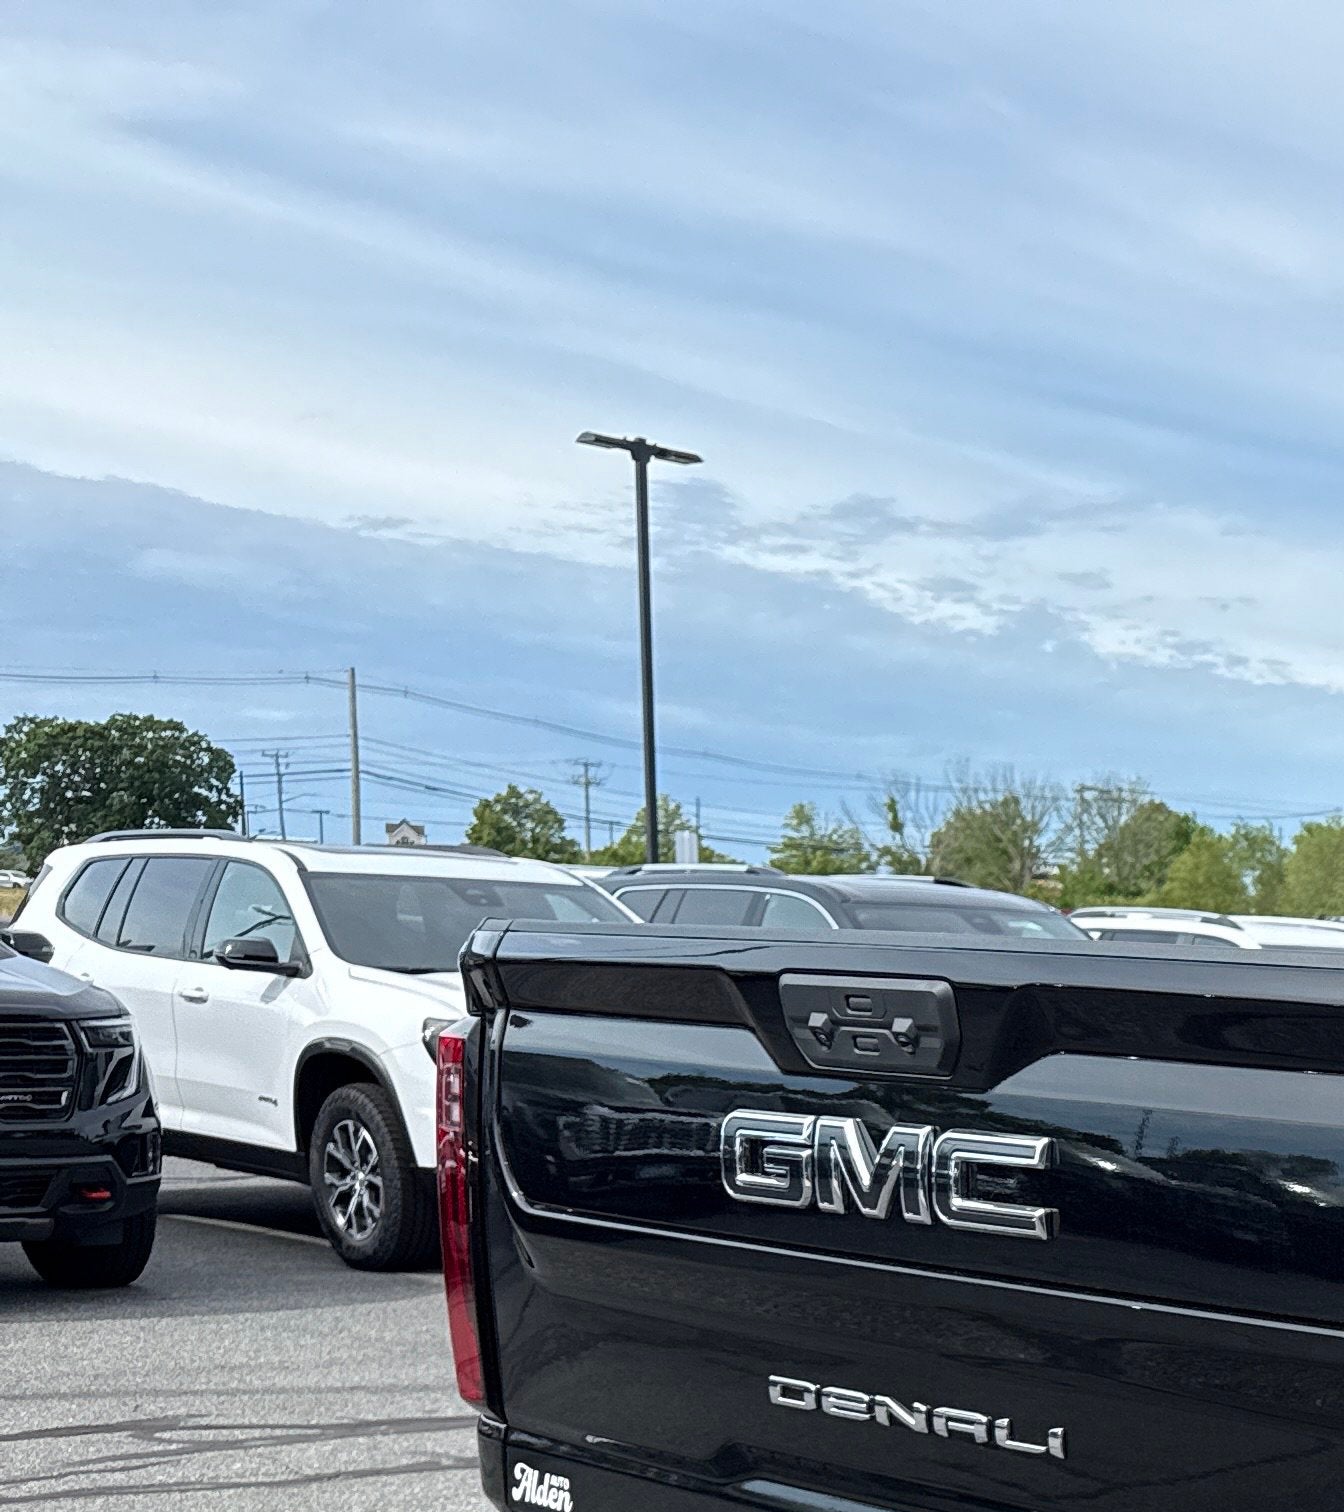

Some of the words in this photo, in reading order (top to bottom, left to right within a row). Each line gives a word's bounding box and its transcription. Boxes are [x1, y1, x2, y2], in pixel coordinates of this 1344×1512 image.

[720, 1109, 1060, 1240] GMC
[768, 1374, 1066, 1460] DENALI
[550, 1474, 570, 1490] AUTO
